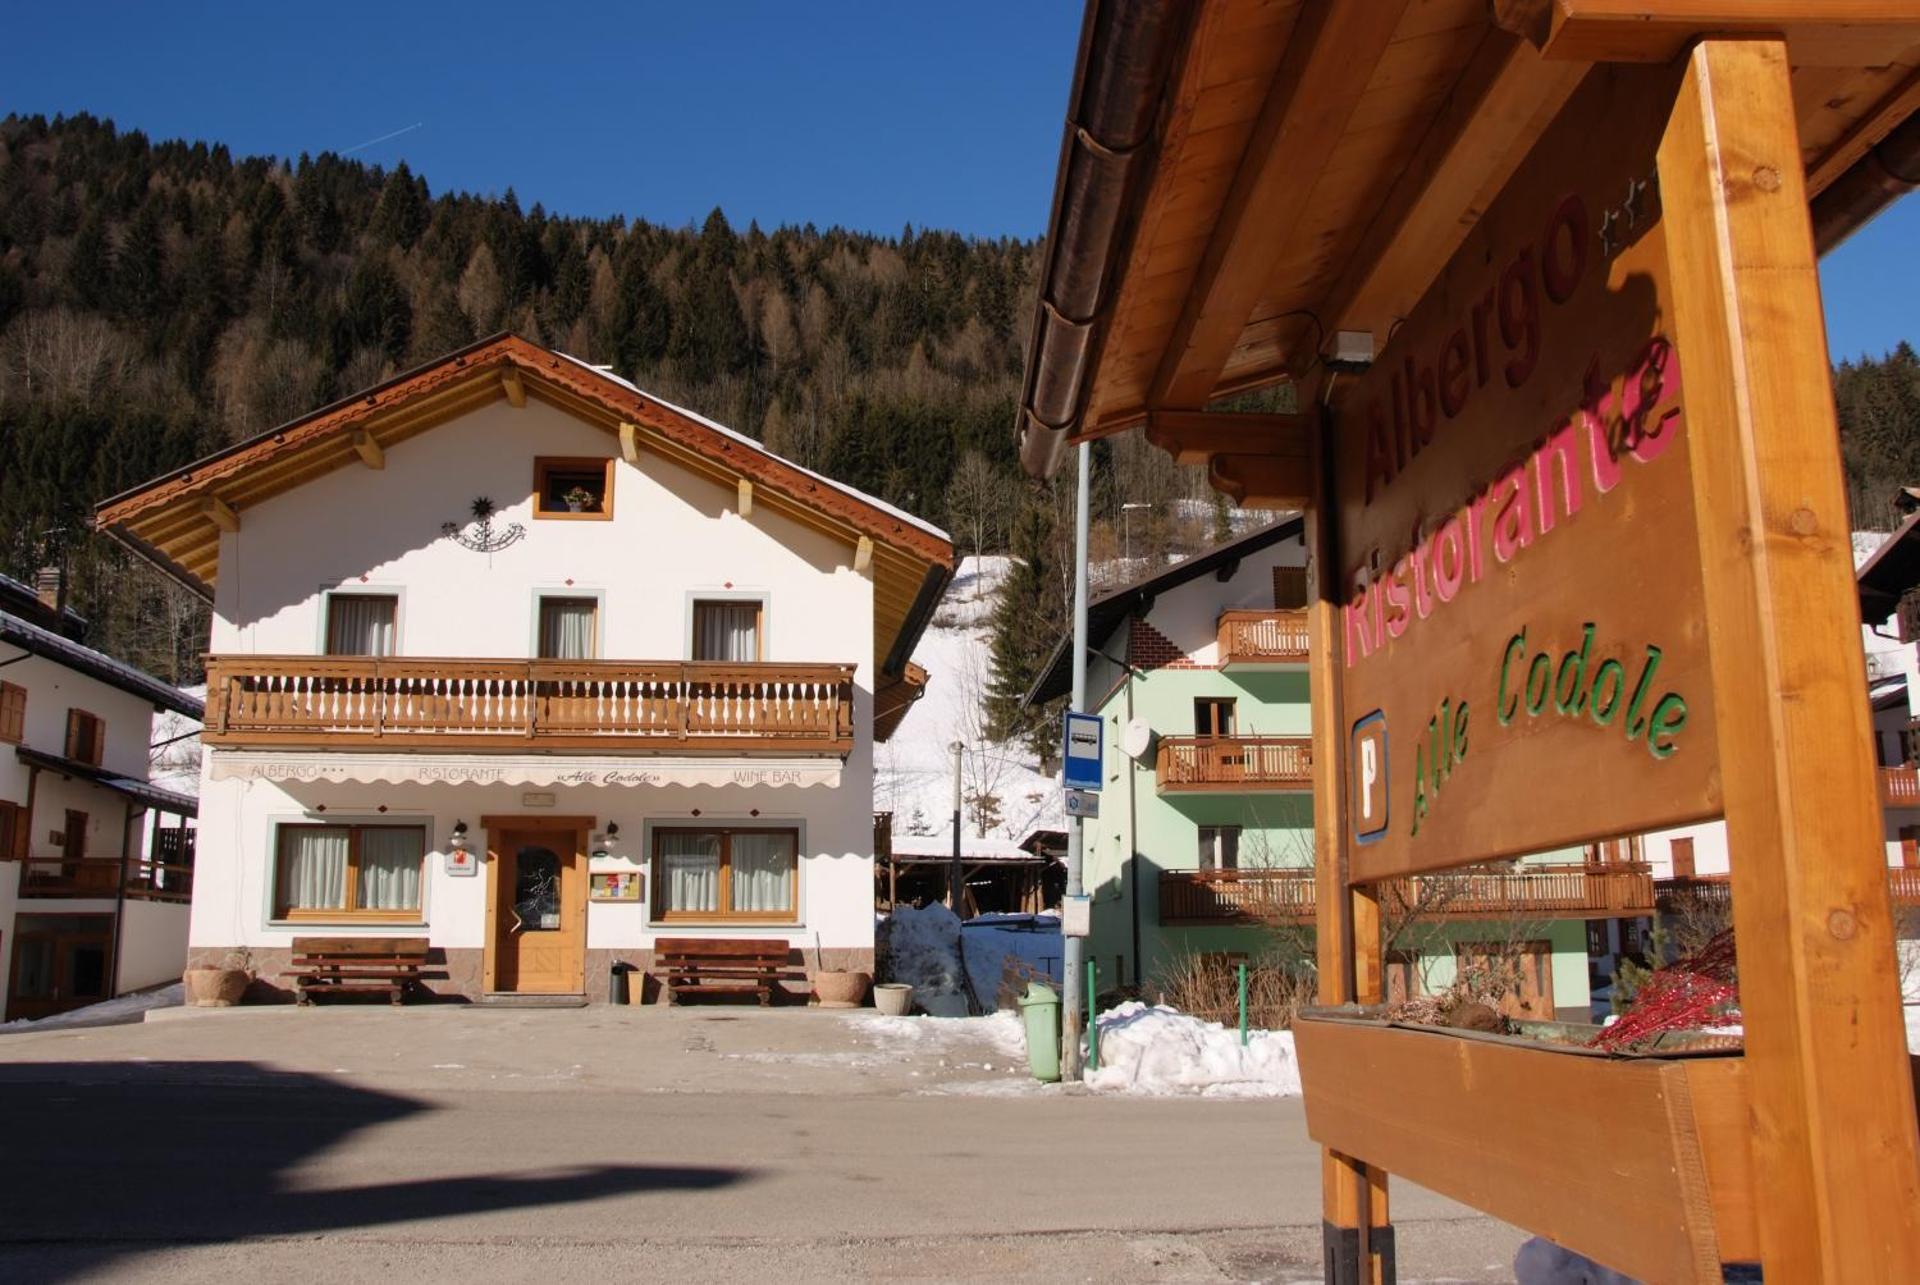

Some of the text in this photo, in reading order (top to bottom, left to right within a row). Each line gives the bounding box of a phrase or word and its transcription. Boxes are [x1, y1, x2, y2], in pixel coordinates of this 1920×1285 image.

[1363, 190, 1590, 507] Albergo
[1346, 335, 1681, 668] Ristorante
[251, 764, 317, 778] ALBERGO
[1410, 622, 1688, 838] Alle Codole
[418, 767, 507, 780] RISTORANTE
[733, 769, 802, 784] WINE BAR
[1360, 737, 1377, 819] P
